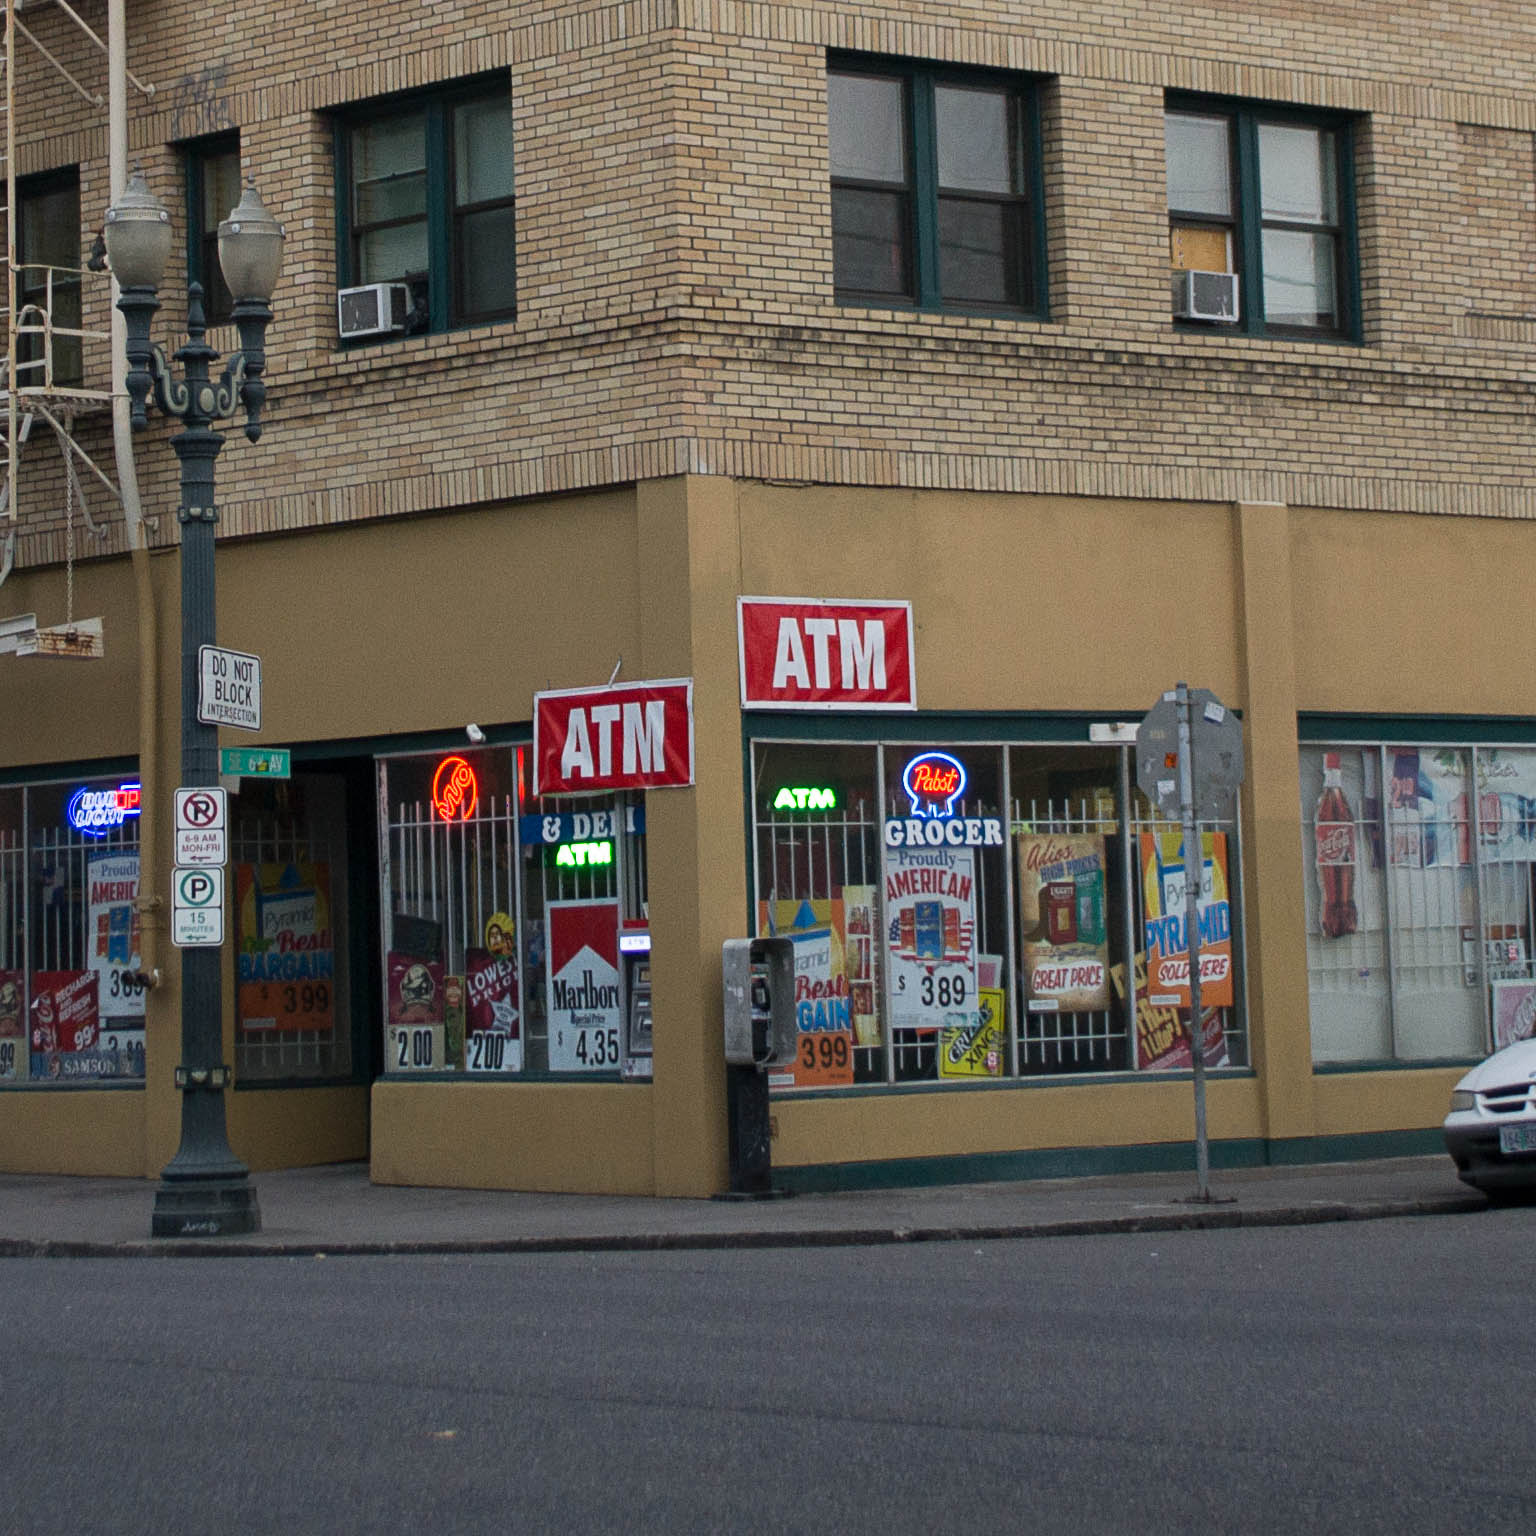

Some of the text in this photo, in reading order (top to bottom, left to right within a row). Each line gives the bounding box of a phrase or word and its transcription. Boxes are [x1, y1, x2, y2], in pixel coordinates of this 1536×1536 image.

[772, 616, 887, 690] ATM
[212, 655, 254, 683] DO NOT
[215, 680, 253, 707] BLOCK
[207, 703, 257, 723] INTERSECTION
[561, 700, 666, 779] ATM
[913, 764, 959, 794] Pabst
[116, 789, 140, 810] OP
[774, 788, 836, 809] ATM
[76, 808, 125, 827] LIGHT
[542, 816, 561, 843] &
[181, 844, 221, 853] MON-FRI
[202, 834, 217, 842] AM
[556, 841, 612, 866] ATM
[899, 850, 957, 870] Proudly
[101, 861, 139, 879] Proudl
[91, 880, 141, 905] AMERIC
[885, 868, 973, 902] AMERICAN
[190, 912, 205, 924] 15
[239, 951, 333, 981] BARGAIN
[794, 948, 830, 971] ramid
[1159, 960, 1190, 982] SOLD
[795, 974, 844, 1002] Best
[898, 975, 905, 990] $
[1033, 964, 1103, 991] GREAT PRICE
[796, 999, 851, 1032] GAIN
[576, 1029, 619, 1065] 4.35
[64, 1058, 115, 1076] SAMSON
